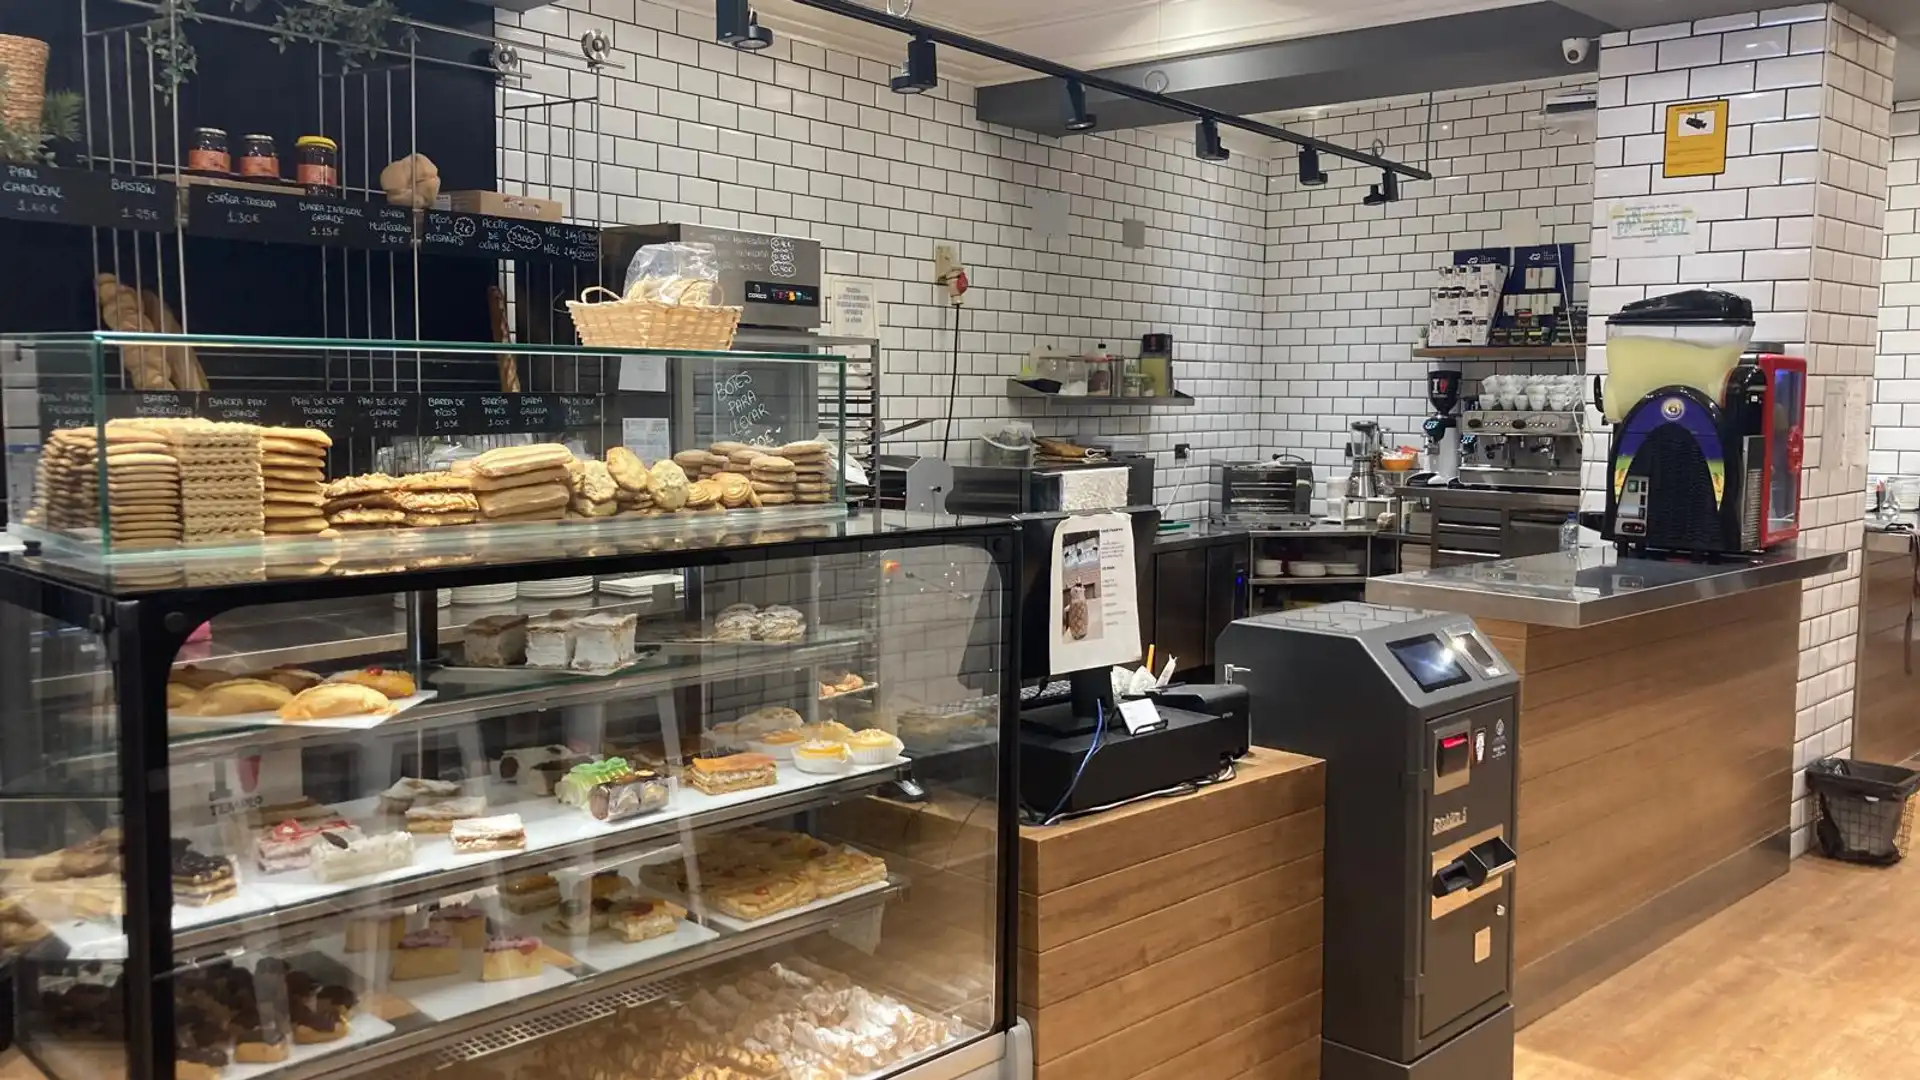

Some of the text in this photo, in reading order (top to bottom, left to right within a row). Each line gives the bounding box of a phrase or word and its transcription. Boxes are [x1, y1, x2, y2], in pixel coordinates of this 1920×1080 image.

[714, 371, 752, 401] BOTES
[728, 389, 757, 416] PARA
[730, 403, 771, 436] LLEVAR
